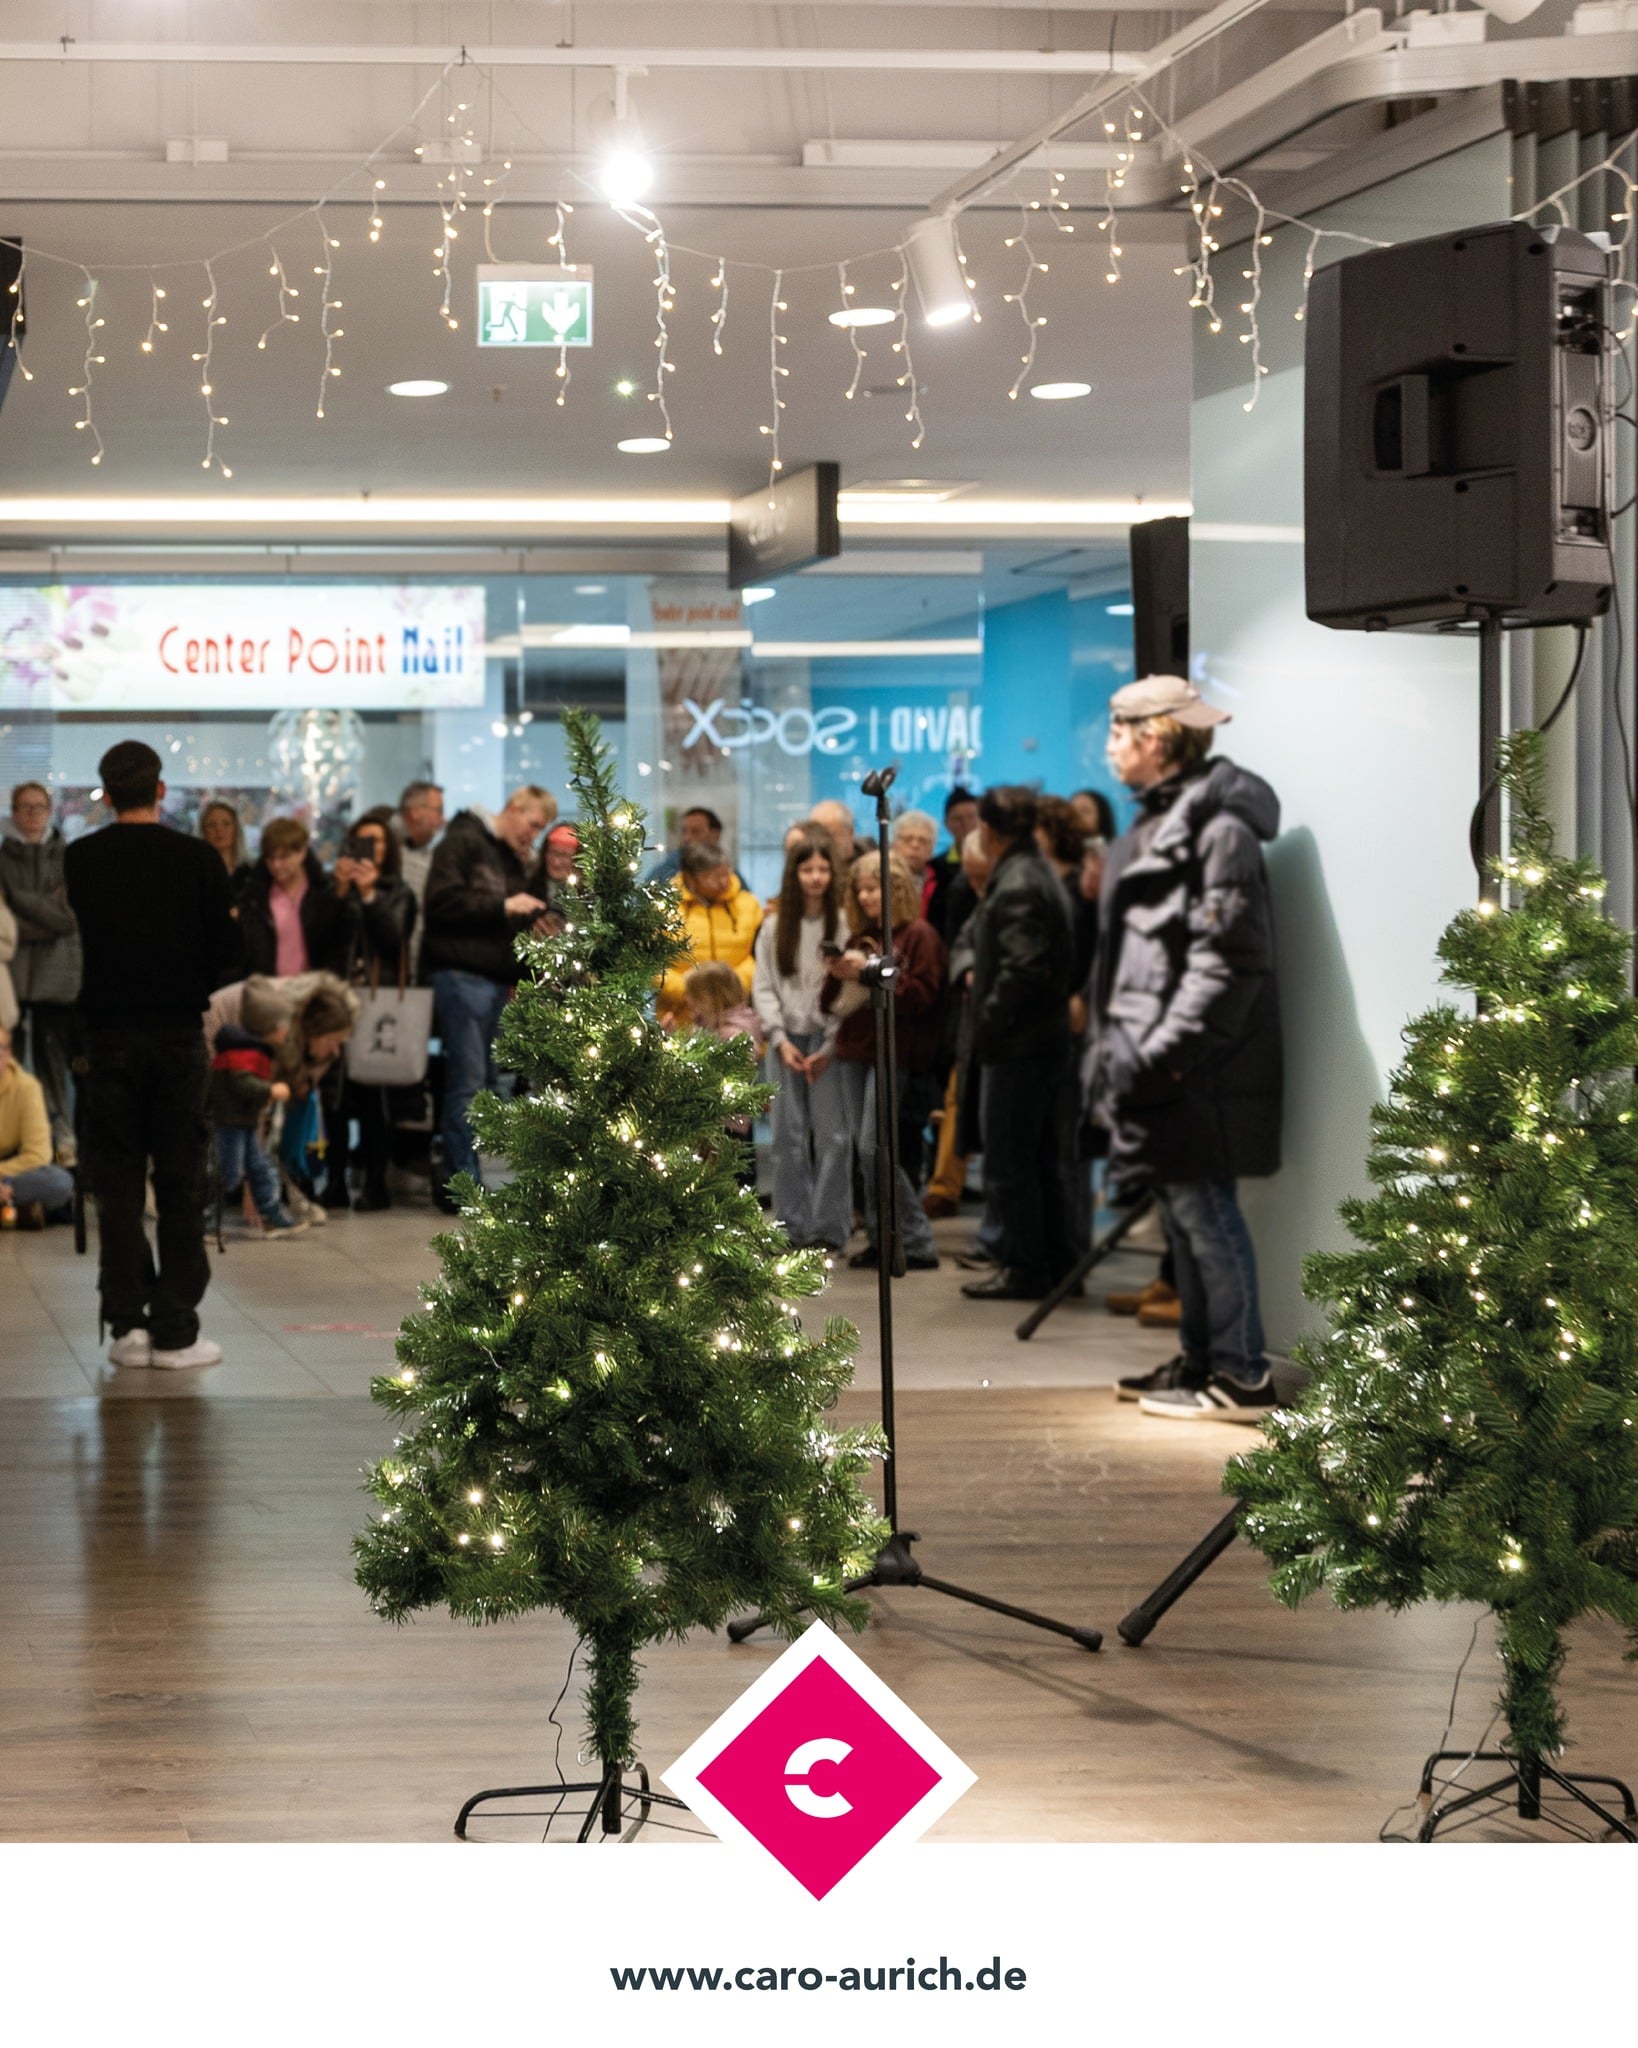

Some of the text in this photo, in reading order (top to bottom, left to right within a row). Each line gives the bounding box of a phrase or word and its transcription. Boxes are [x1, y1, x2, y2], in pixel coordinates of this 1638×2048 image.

[158, 626, 463, 675] Center Point Nail
